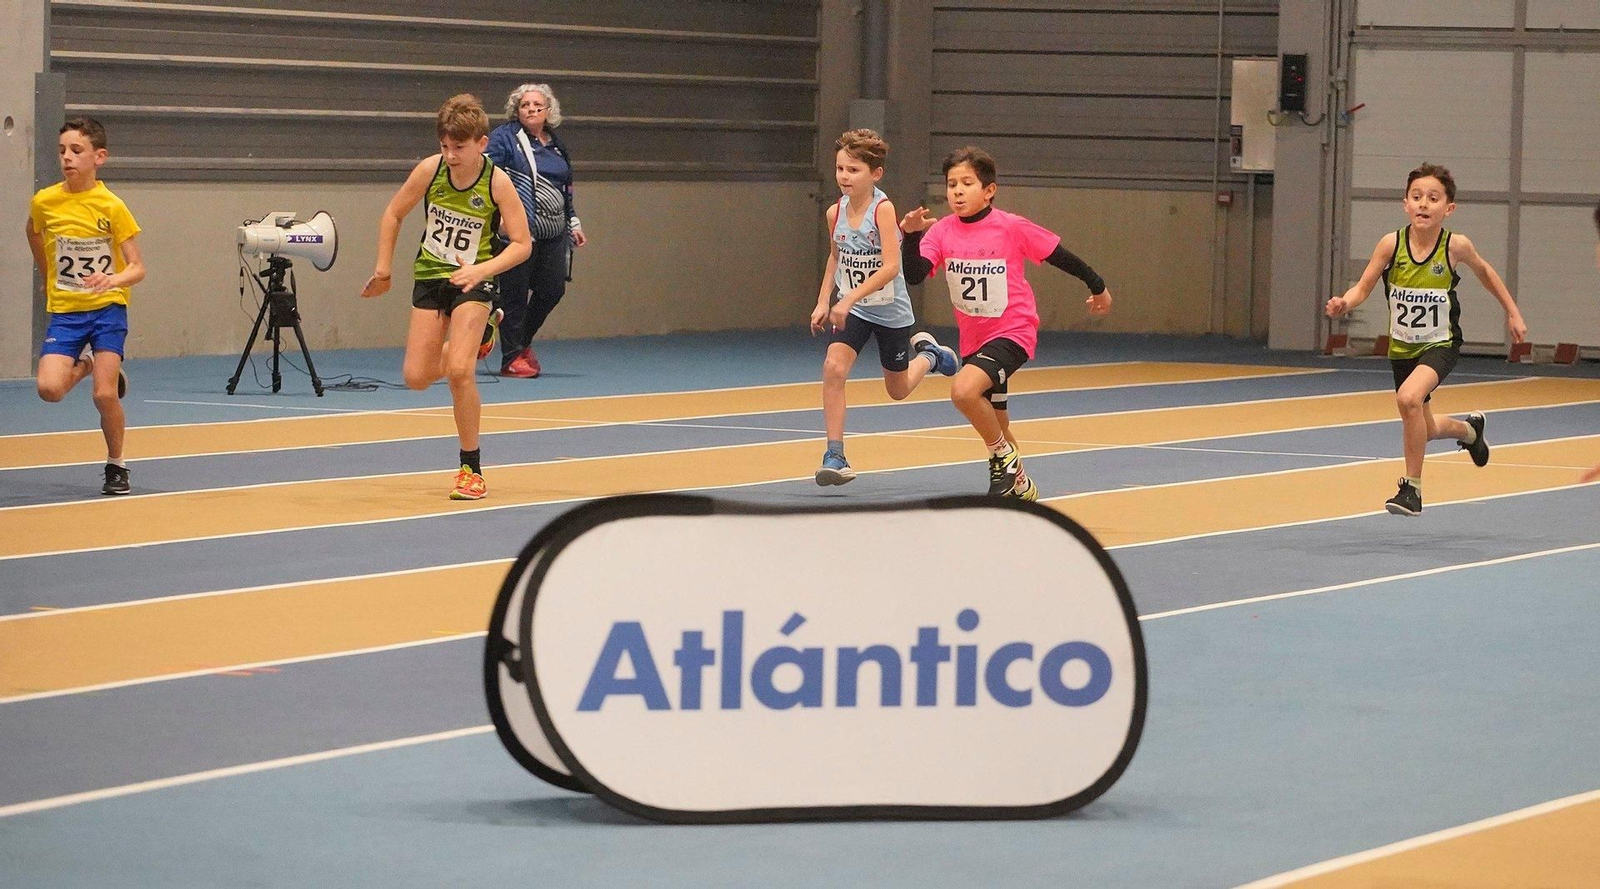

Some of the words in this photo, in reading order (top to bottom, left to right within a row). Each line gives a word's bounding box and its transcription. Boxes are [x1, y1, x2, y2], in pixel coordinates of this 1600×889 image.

[430, 206, 482, 230] Atlántico
[295, 235, 317, 243] LYNX
[432, 219, 472, 251] 216
[59, 255, 113, 279] 232
[947, 261, 1006, 275] Atlántico
[960, 276, 988, 302] 21
[1391, 288, 1447, 303] Atlántico
[1396, 302, 1439, 329] 221
[576, 608, 1113, 712] Atlántico
